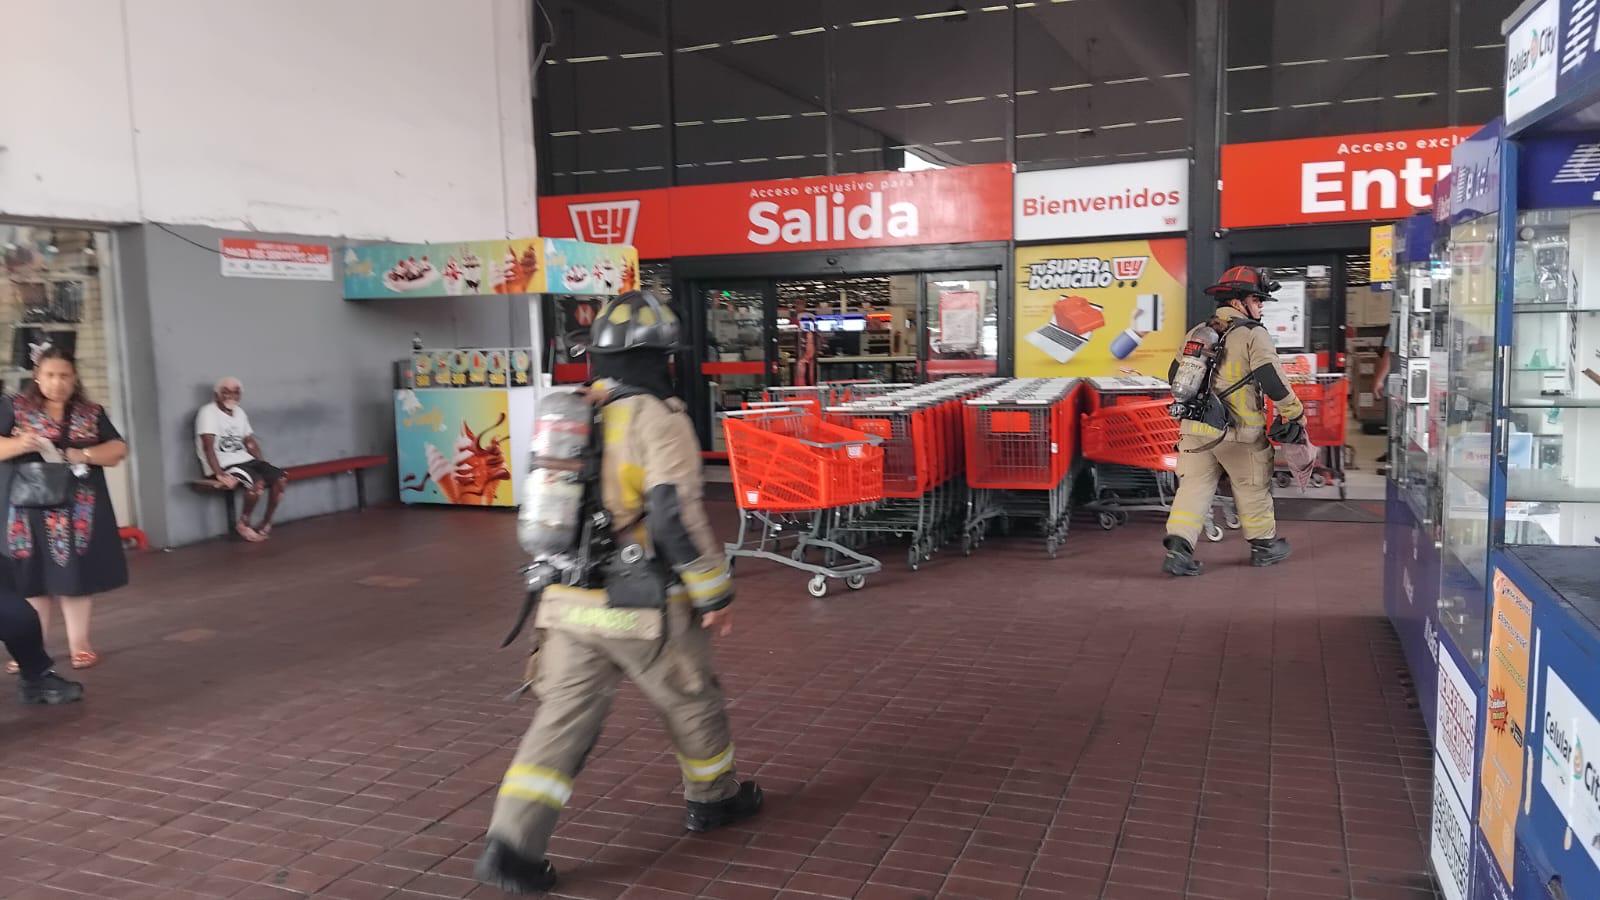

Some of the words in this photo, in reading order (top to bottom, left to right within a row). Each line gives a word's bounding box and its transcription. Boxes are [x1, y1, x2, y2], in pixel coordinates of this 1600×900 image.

[1539, 26, 1557, 57] City
[1337, 140, 1407, 154] Acceso
[750, 187, 799, 199] Acceso
[804, 181, 873, 194] exclusivo
[880, 179, 914, 191] para
[1023, 187, 1180, 217] Bienvenidos
[747, 192, 919, 245] Salida
[1031, 264, 1047, 275] TU
[1046, 258, 1099, 273] SUPER
[1100, 261, 1111, 272] A
[1029, 272, 1113, 290] DOMICILIO
[1545, 711, 1572, 762] Celular
[1585, 761, 1600, 811] Cit
